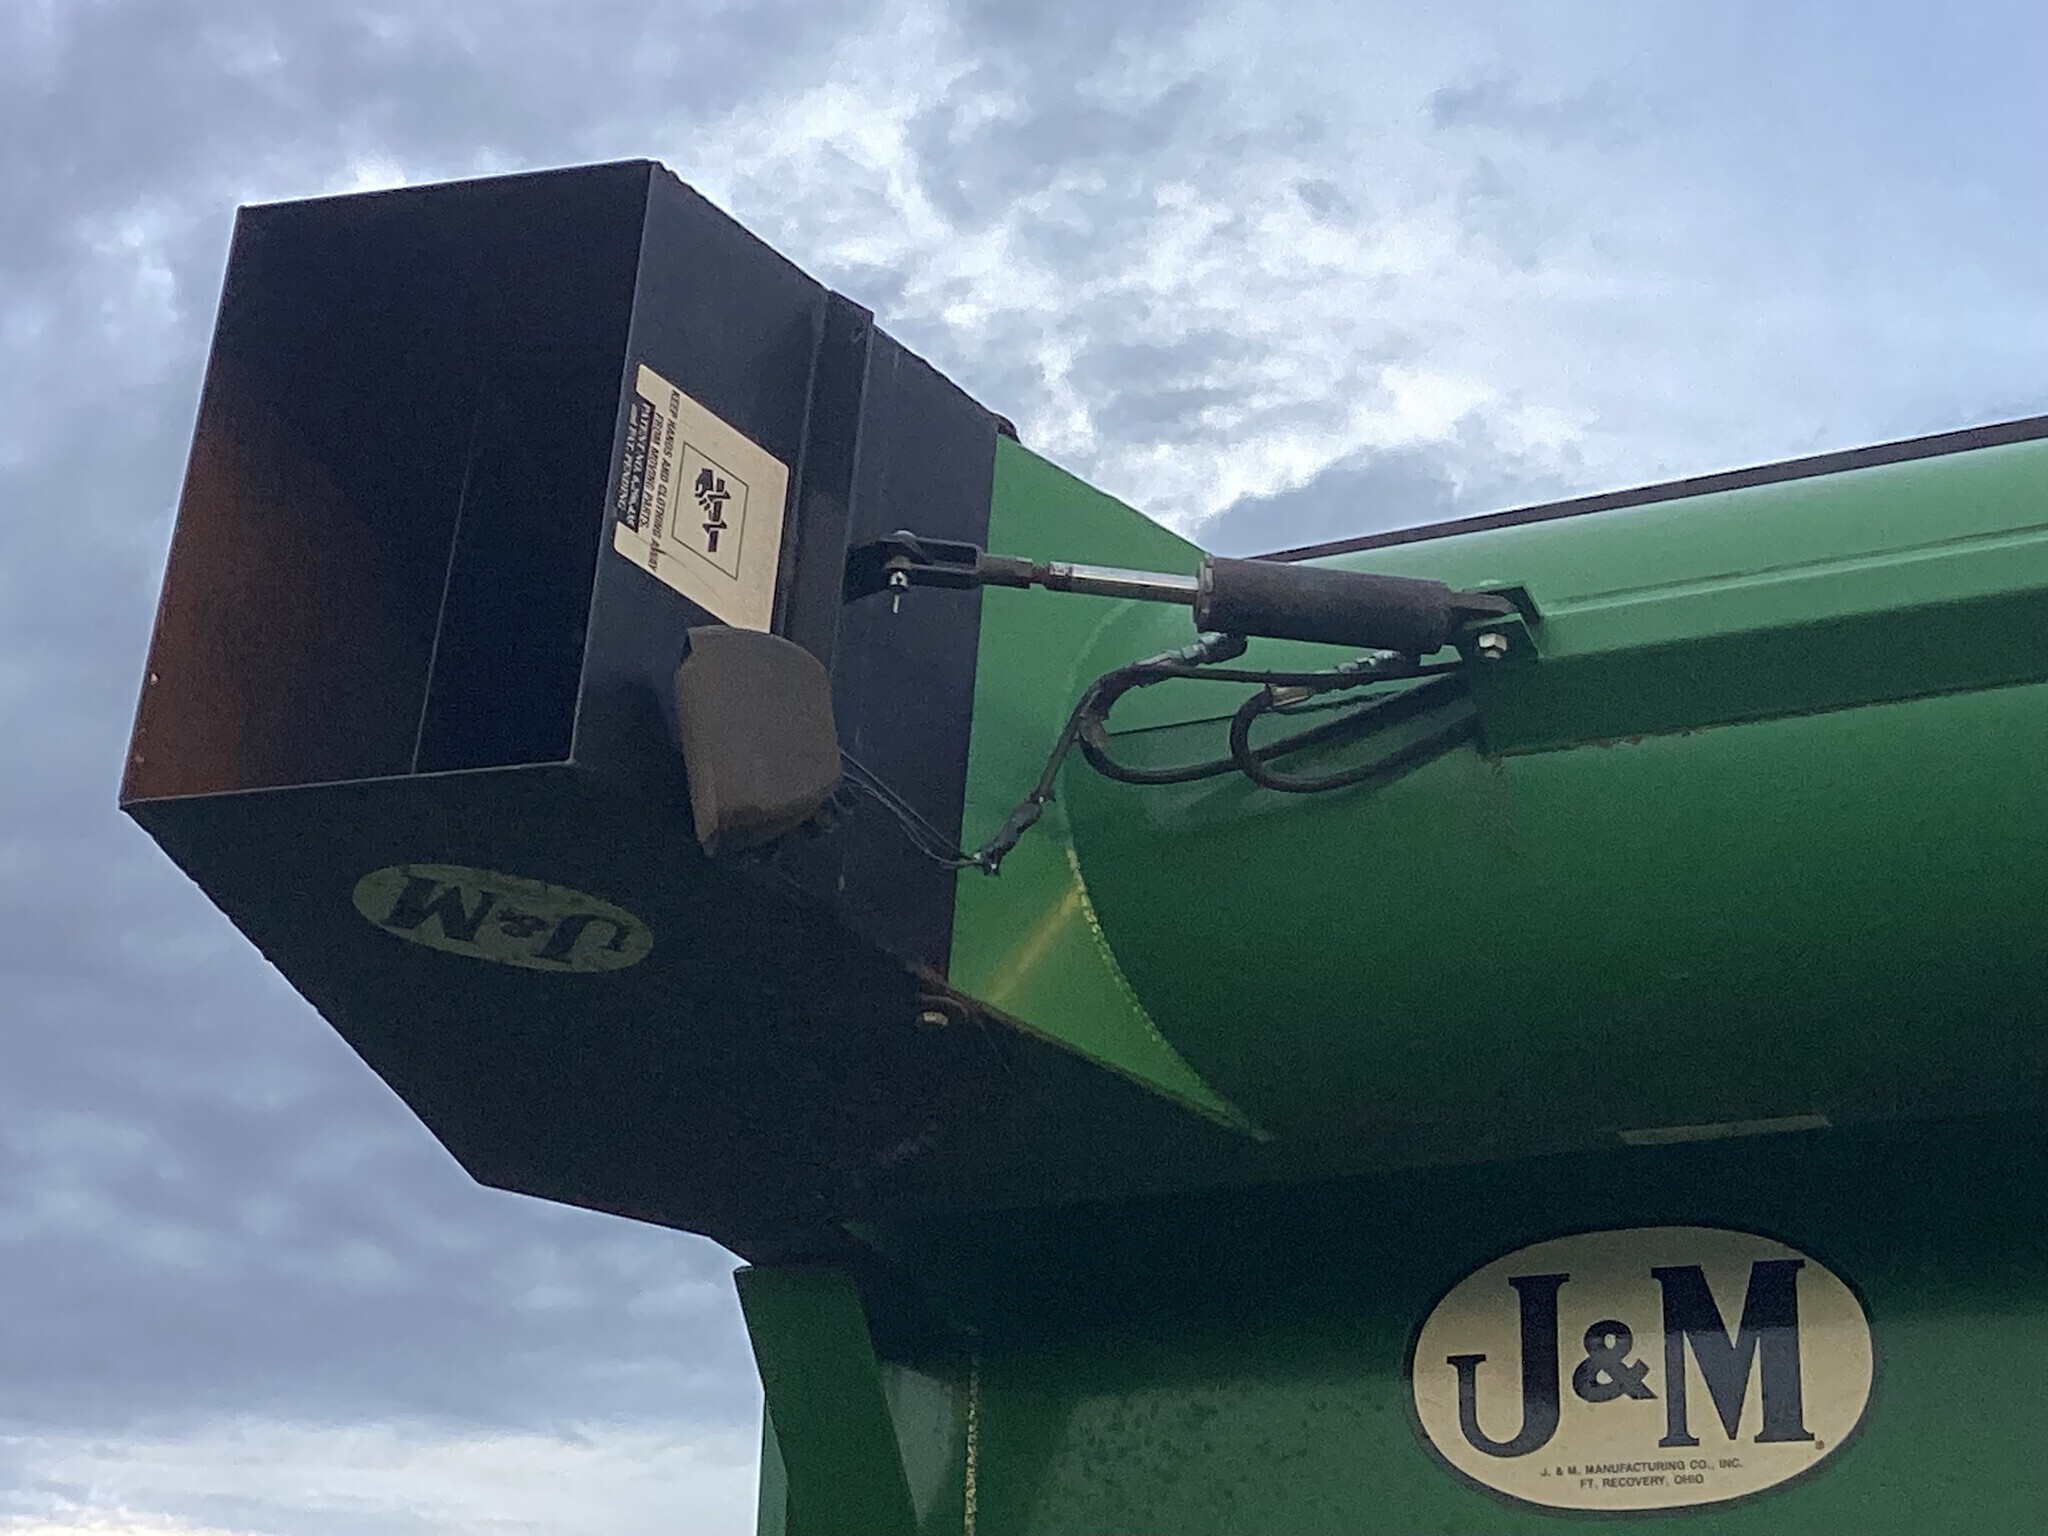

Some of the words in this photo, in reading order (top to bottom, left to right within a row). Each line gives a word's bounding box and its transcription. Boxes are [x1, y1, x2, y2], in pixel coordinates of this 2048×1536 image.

[668, 388, 680, 419] KEEP
[651, 411, 663, 446] FROM
[663, 417, 676, 458] HANDS
[617, 450, 632, 512] PENDING
[645, 445, 659, 492] MOVING
[659, 457, 670, 484] AND
[652, 482, 667, 539] CLOTHING
[647, 537, 659, 572] AWAY
[383, 876, 633, 964] J&M
[1446, 1258, 1816, 1458] J&M
[1556, 1466, 1563, 1476] &
[1585, 1459, 1686, 1475] MANUFACTURING
[1719, 1457, 1743, 1469] INC.
[1602, 1475, 1668, 1489] RECOVERY,
[1674, 1474, 1705, 1485] OHIO
